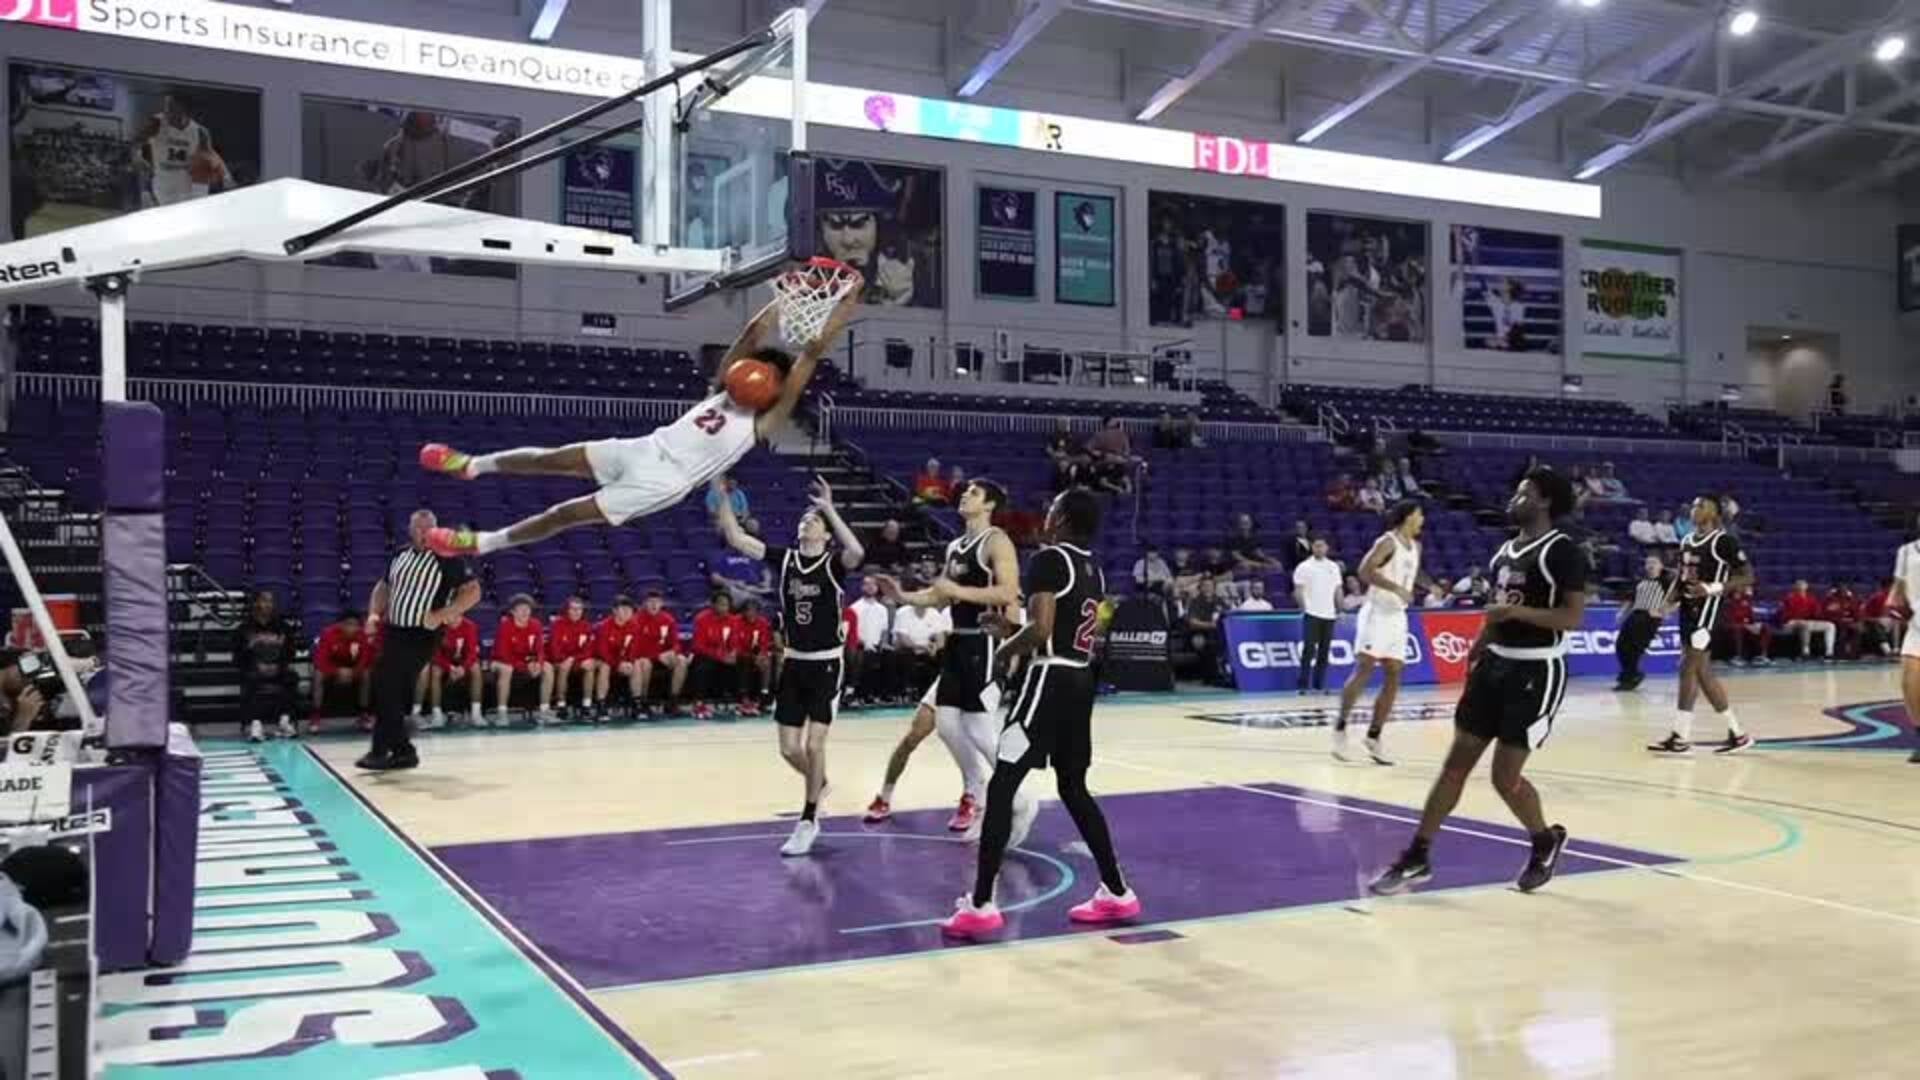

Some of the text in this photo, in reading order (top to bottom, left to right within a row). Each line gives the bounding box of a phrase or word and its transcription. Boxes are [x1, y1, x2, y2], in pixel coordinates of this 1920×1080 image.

[89, 0, 209, 37] Sports
[222, 15, 390, 61] Insurance
[1198, 136, 1268, 176] FDL
[694, 408, 726, 435] 23
[796, 601, 812, 624] 5
[13, 736, 35, 754] G
